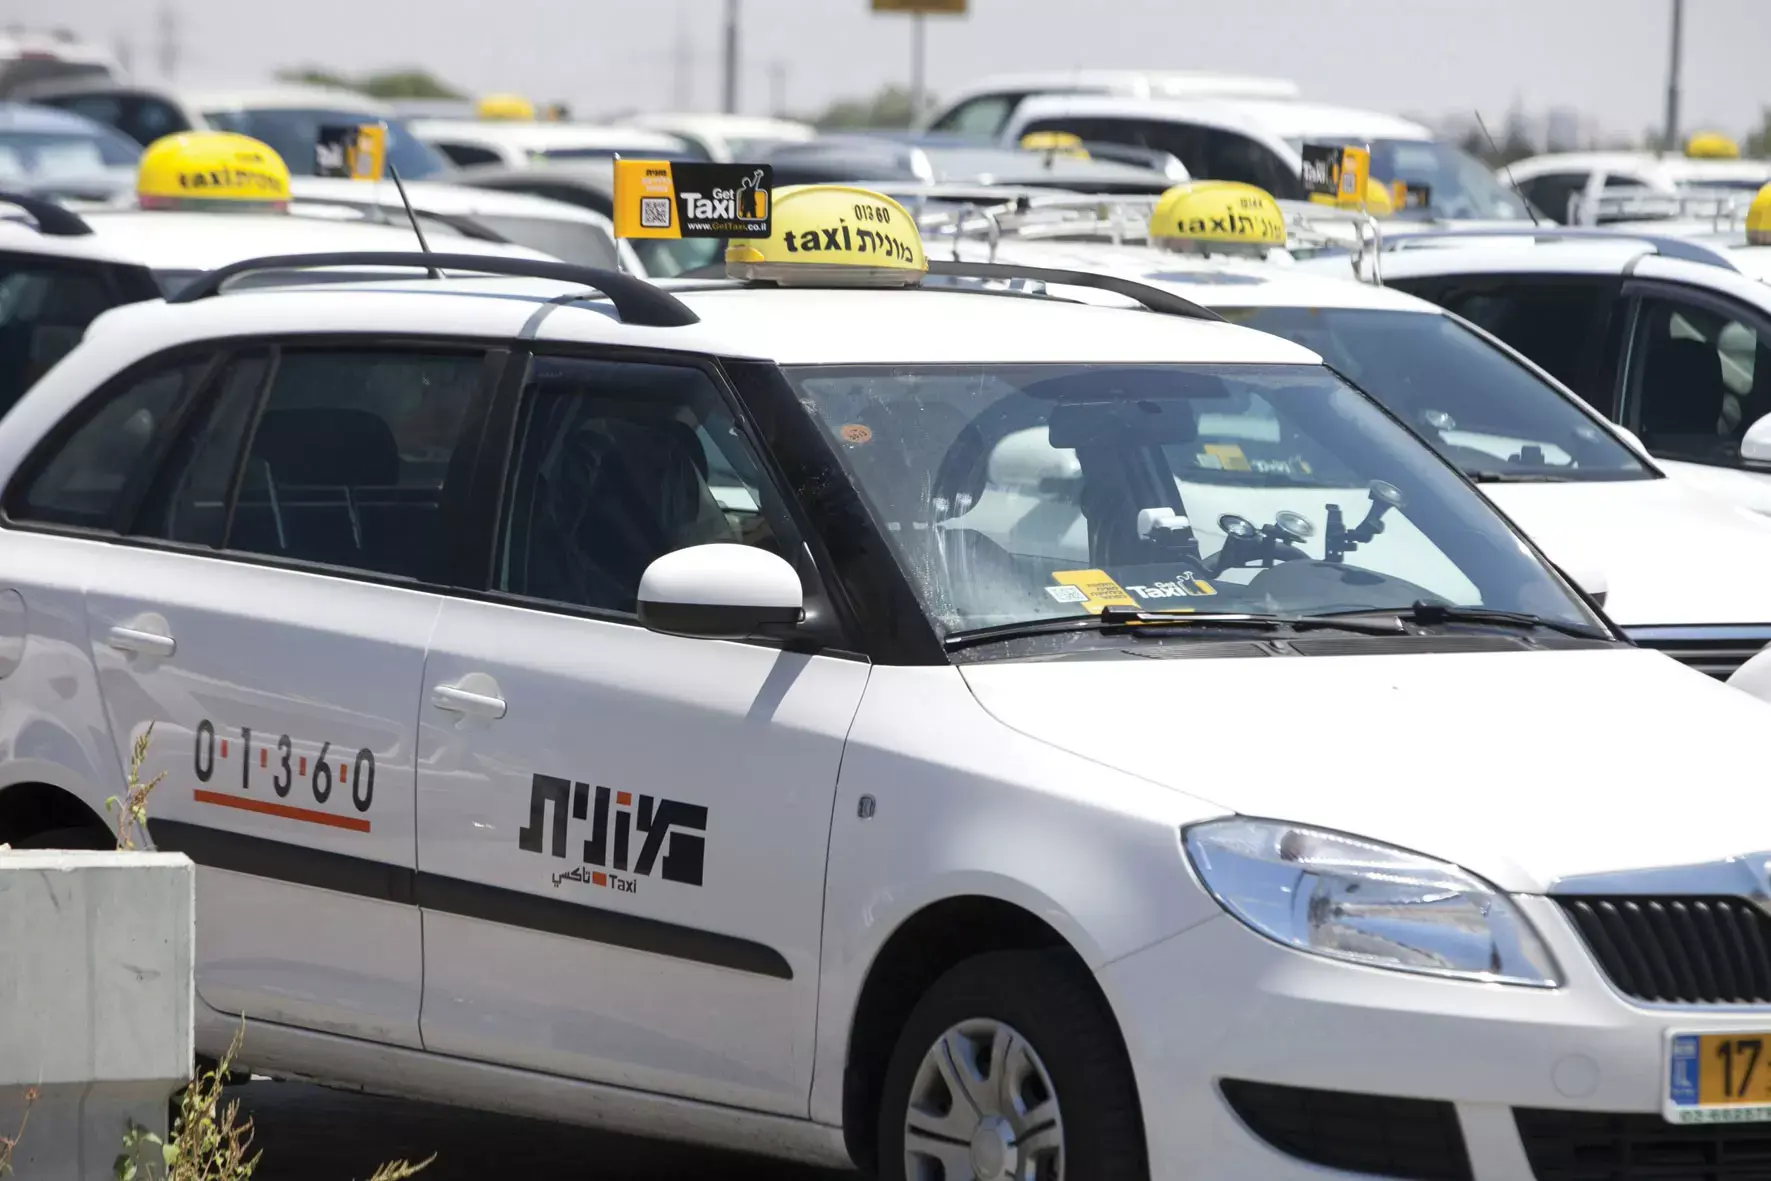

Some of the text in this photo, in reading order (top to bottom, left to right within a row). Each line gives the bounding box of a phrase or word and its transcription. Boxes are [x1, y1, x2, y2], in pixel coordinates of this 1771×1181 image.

[712, 188, 735, 200] Get
[680, 192, 734, 219] Taxi
[853, 204, 890, 224] 01360
[687, 221, 767, 232] www.GetTaxi.co.il
[784, 218, 852, 252] taxi
[856, 227, 914, 263] מונית
[1125, 585, 1187, 599] Taxi
[519, 773, 708, 887] מונית
[552, 866, 590, 888] تاكسي
[609, 874, 637, 894] Taxi
[1716, 1039, 1771, 1098] 17
